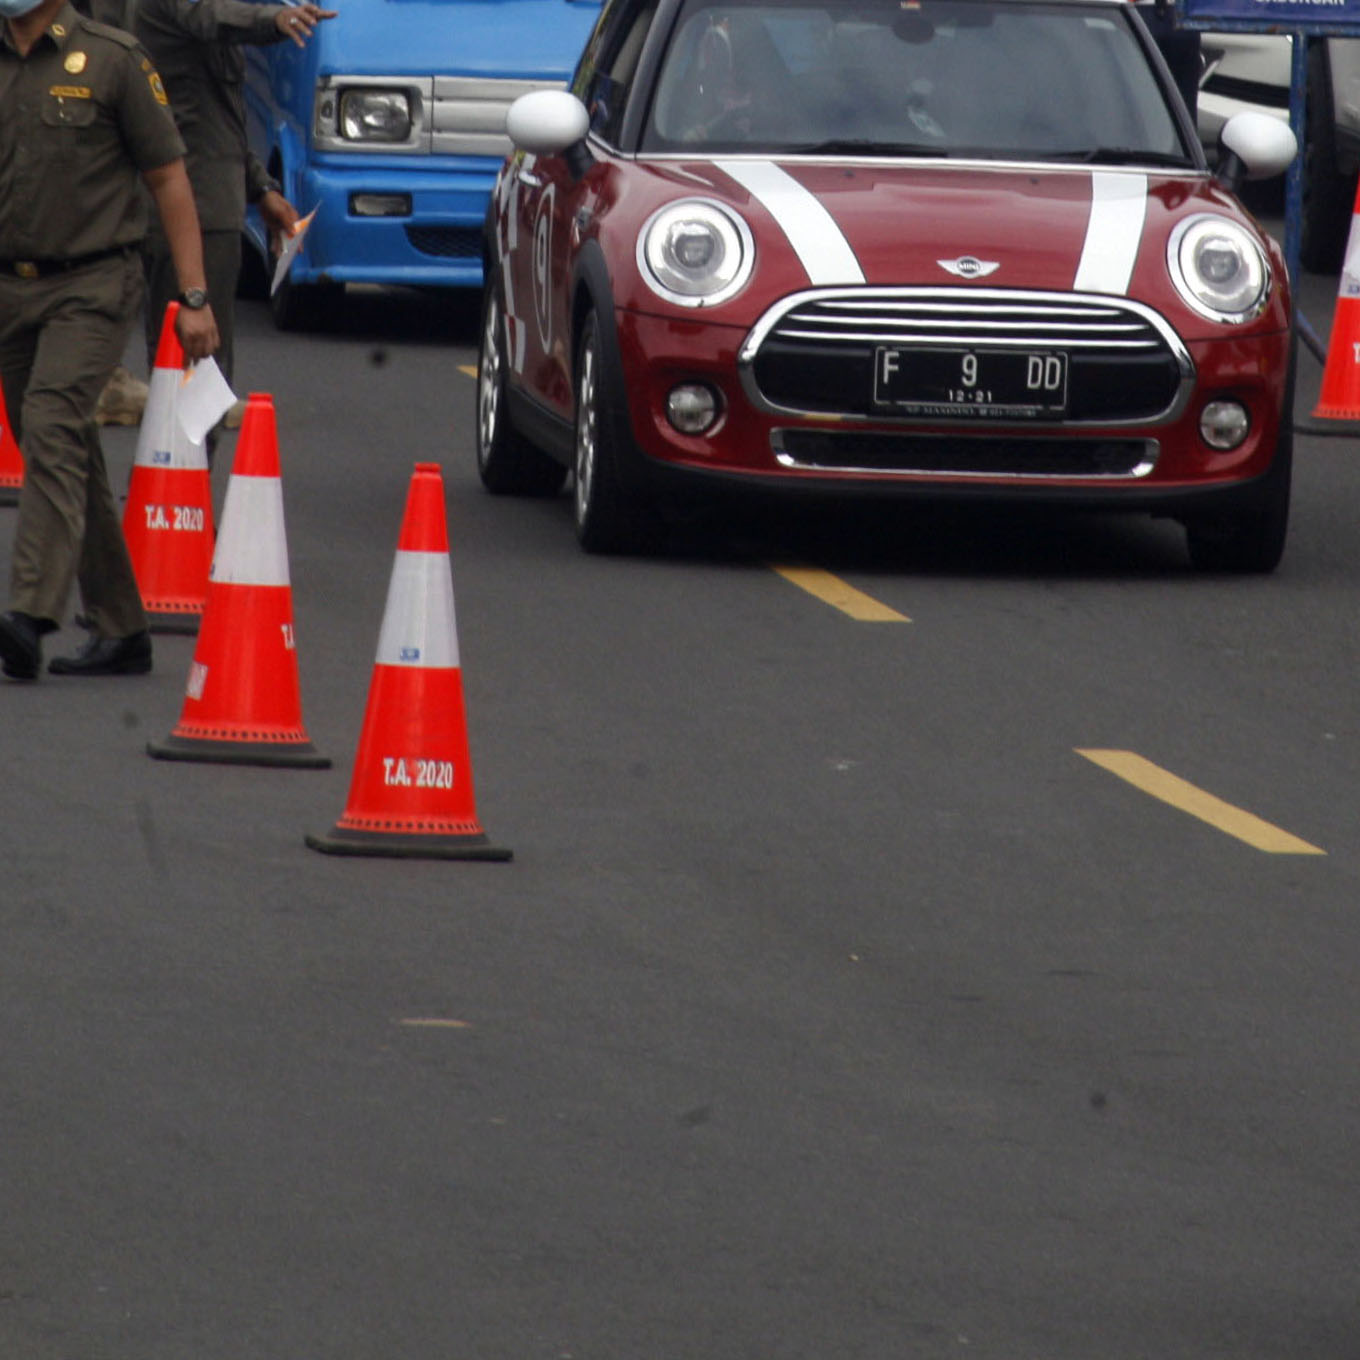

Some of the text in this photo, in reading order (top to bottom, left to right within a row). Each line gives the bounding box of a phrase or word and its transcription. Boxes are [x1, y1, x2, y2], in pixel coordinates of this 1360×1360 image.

[883, 350, 1061, 390] F 9 DD
[144, 505, 204, 532] T.A. 2020
[383, 757, 453, 789] T.A. 2020
